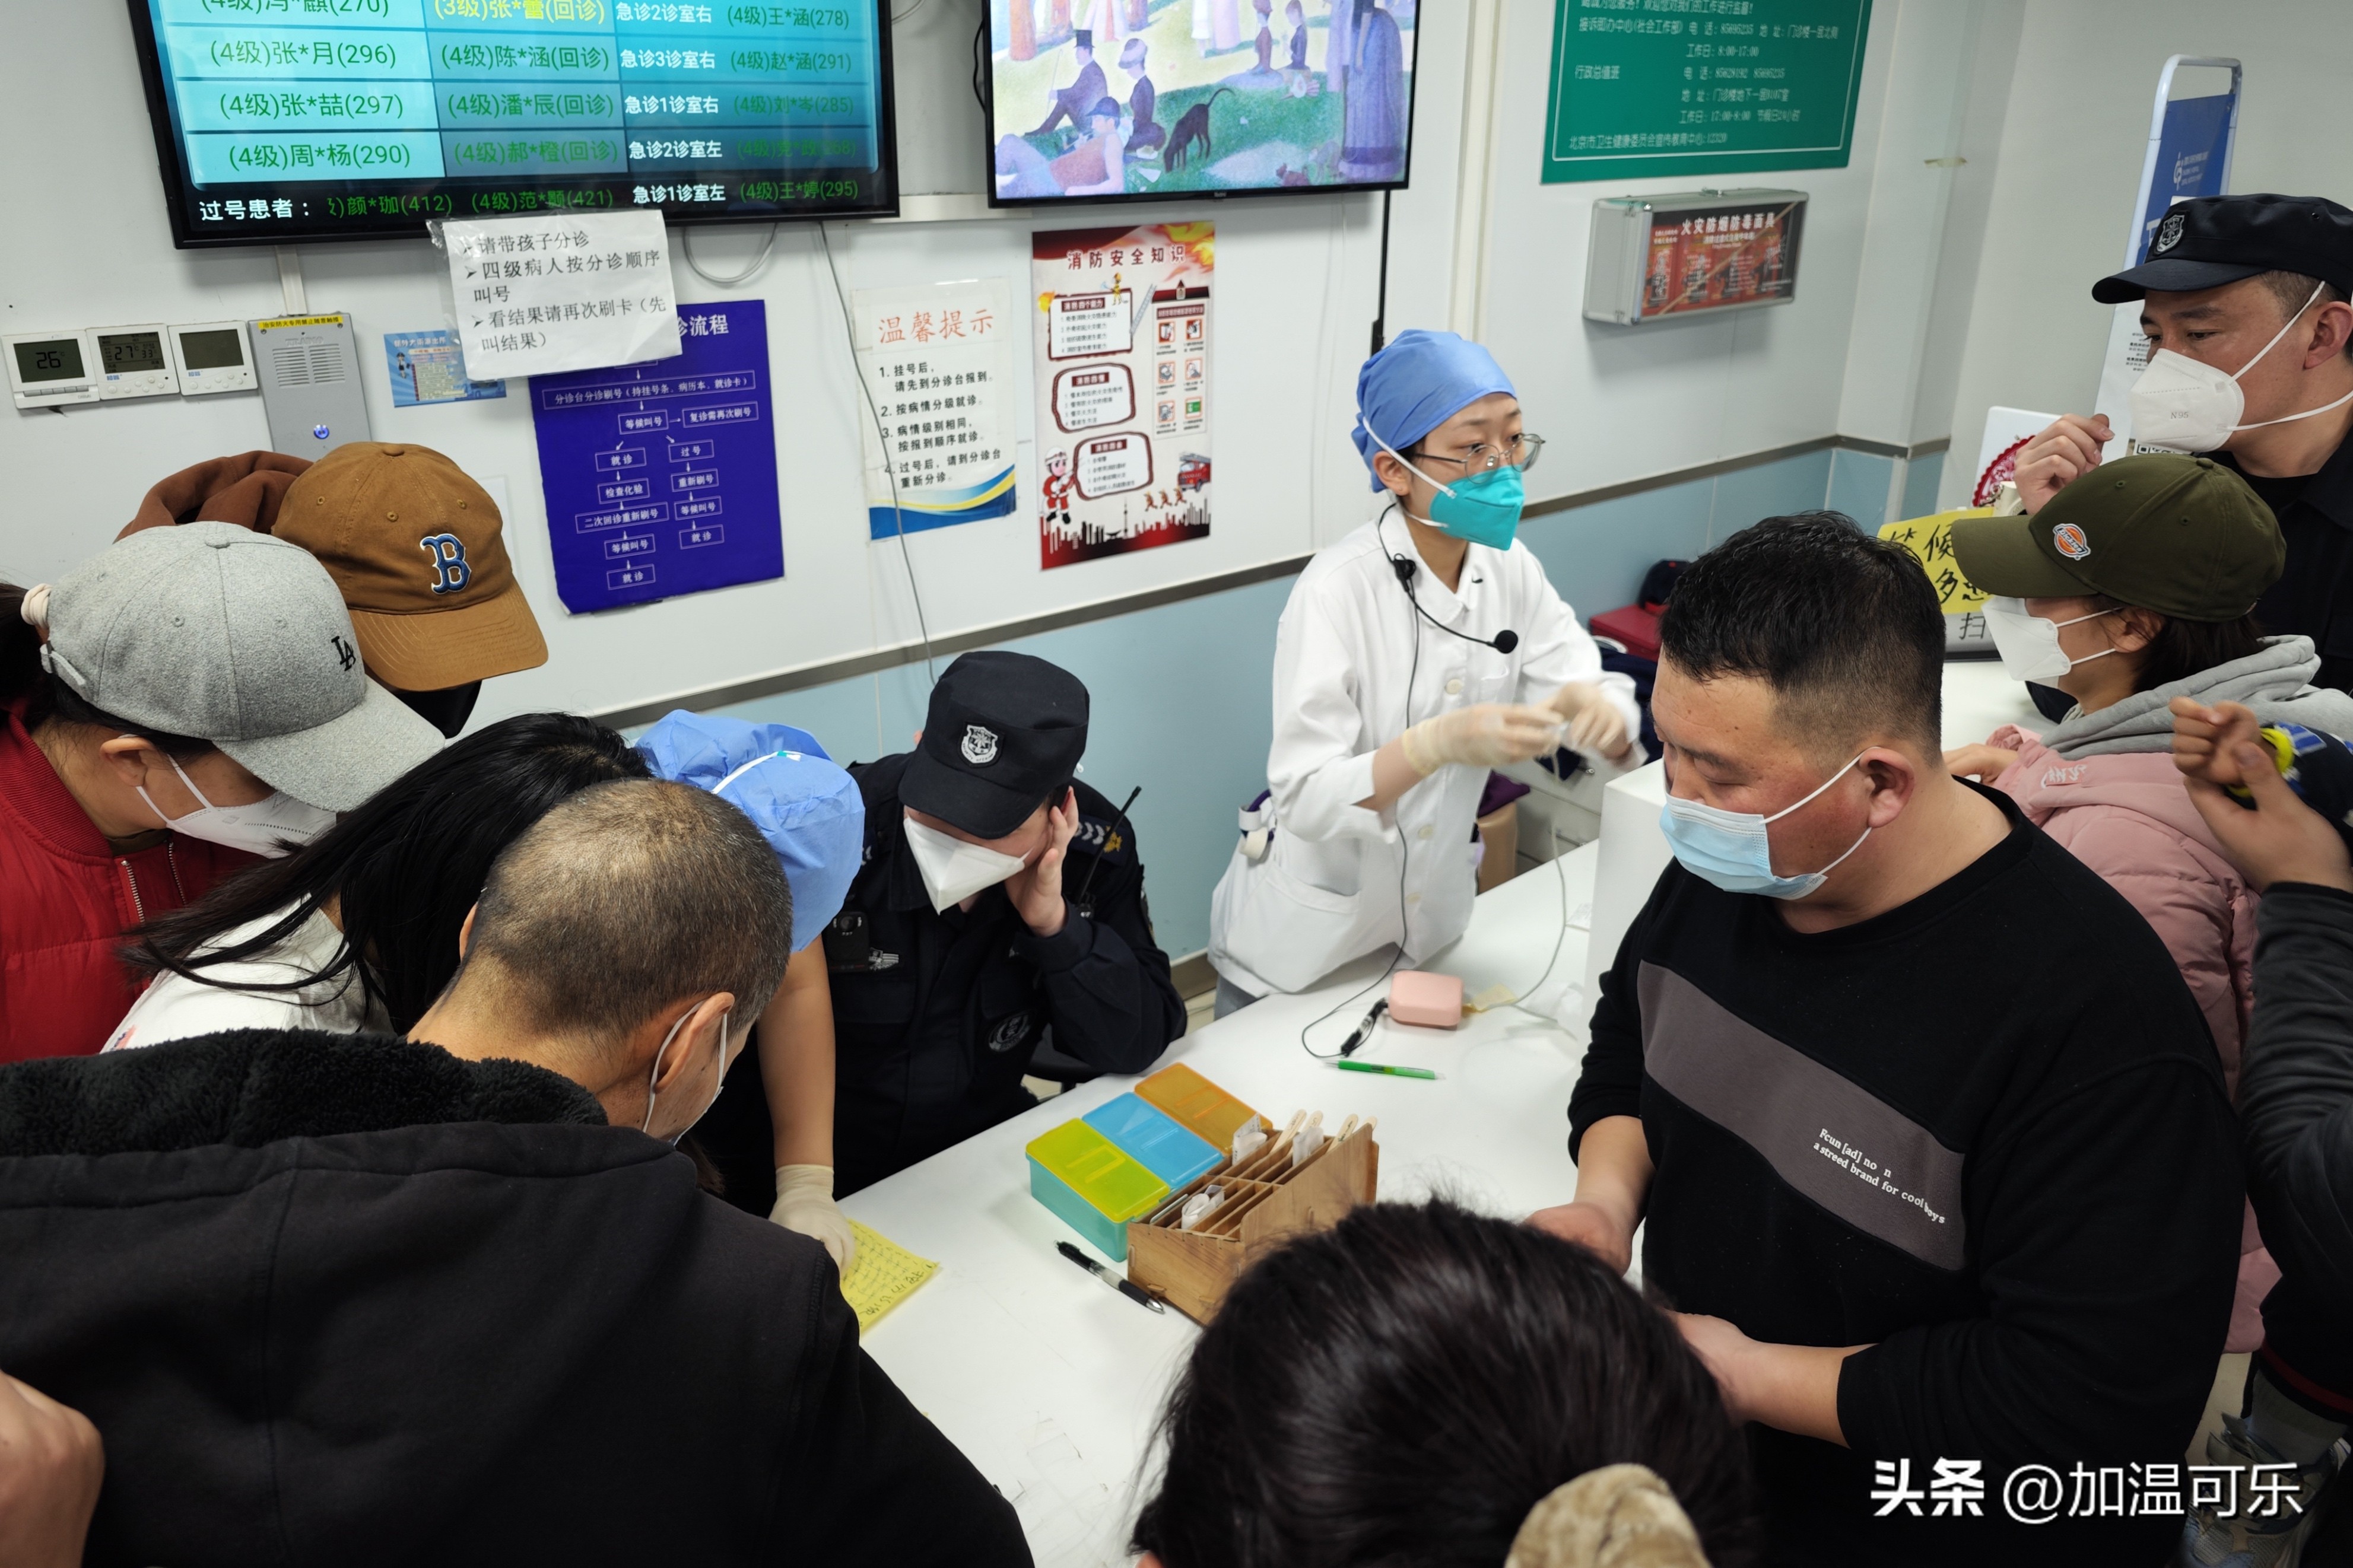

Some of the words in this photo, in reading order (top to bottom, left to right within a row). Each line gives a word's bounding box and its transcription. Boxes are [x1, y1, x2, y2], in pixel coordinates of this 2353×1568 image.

[615, 2, 712, 24] 急诊2诊室右
[620, 49, 716, 69] 急诊3诊室右
[624, 95, 719, 115] 急诊1诊室右
[628, 139, 723, 160] 急诊2诊室左
[633, 183, 726, 204] 急诊1诊室左
[327, 193, 453, 219] )颜珈(412)
[478, 230, 589, 255] 请带孩子分诊
[482, 250, 660, 281] 四级病人按分诊顺序
[1067, 244, 1186, 271] 消防安全知识
[473, 285, 511, 304] 叫号
[878, 308, 994, 344] 温馨提示
[625, 415, 663, 430] 等候叫号
[689, 406, 752, 424] 复诊需再次刷号
[2170, 411, 2189, 419] N95
[610, 453, 633, 466] 就诊
[680, 444, 701, 457] 过号
[605, 483, 644, 498] 检查化验
[678, 474, 714, 488] 重新刷号
[584, 508, 658, 529] 二次回诊重新刷号
[680, 501, 716, 516] 等候叫号
[611, 539, 649, 554] 等候叫号
[691, 531, 712, 543] 就诊
[419, 533, 472, 594] B
[622, 571, 644, 584] 就诊
[331, 635, 356, 672] LA
[1819, 1128, 1842, 1149] Fcun
[1841, 1143, 1863, 1163] [ad]
[1863, 1157, 1878, 1170] no
[1883, 1168, 1892, 1178] n
[1813, 1142, 1820, 1151] a
[1819, 1146, 1849, 1169] streed
[1850, 1163, 1880, 1187] brand
[1881, 1181, 1899, 1195] for
[1901, 1191, 1925, 1208] cool
